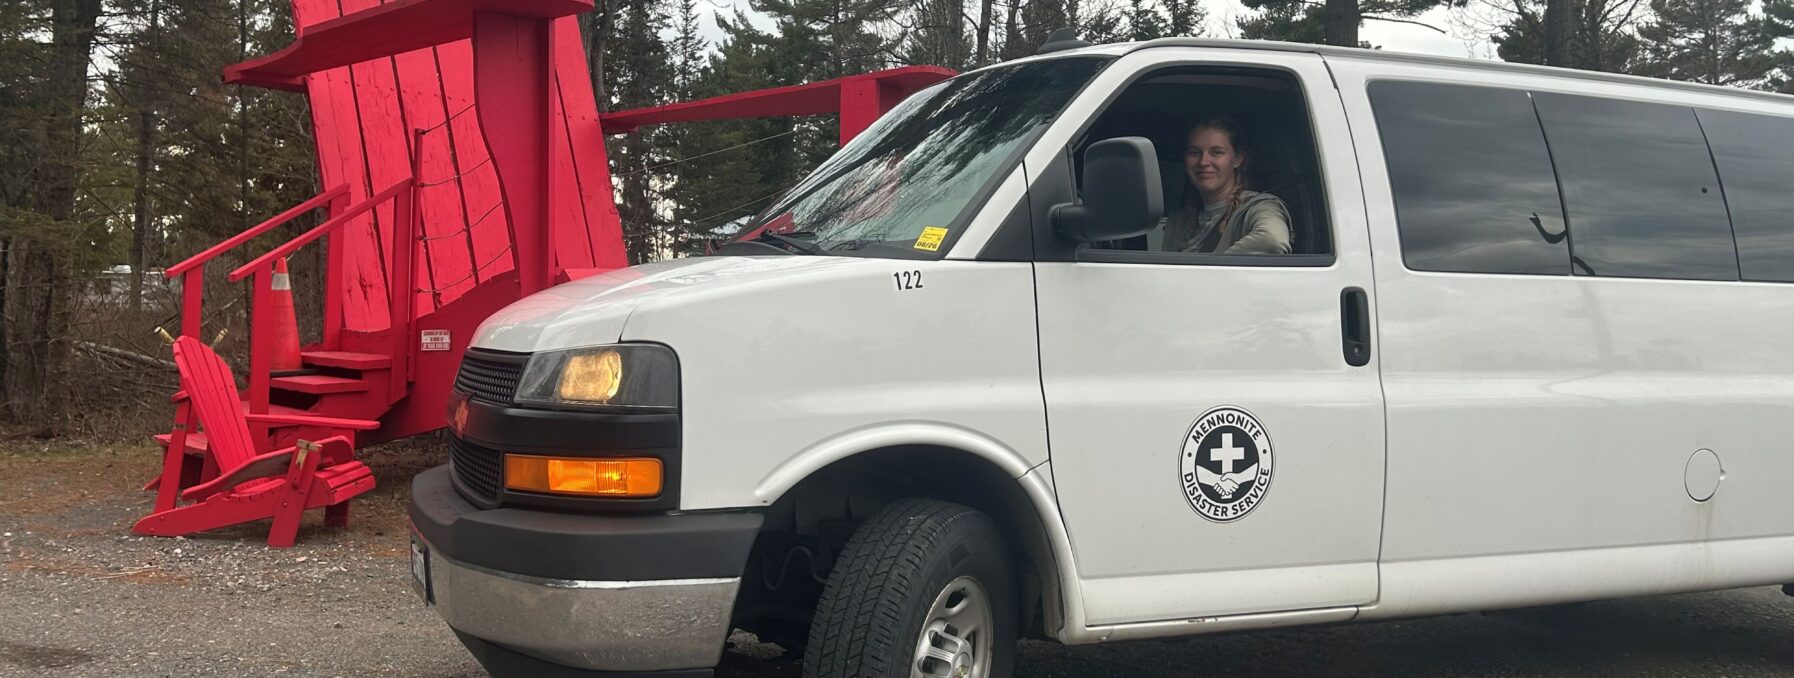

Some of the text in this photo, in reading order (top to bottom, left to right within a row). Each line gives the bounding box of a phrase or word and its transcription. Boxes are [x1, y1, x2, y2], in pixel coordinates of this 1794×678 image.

[893, 270, 923, 290] 122
[1192, 413, 1262, 444] MENNONITE
[1184, 468, 1270, 517] DISASTER SERVICE
